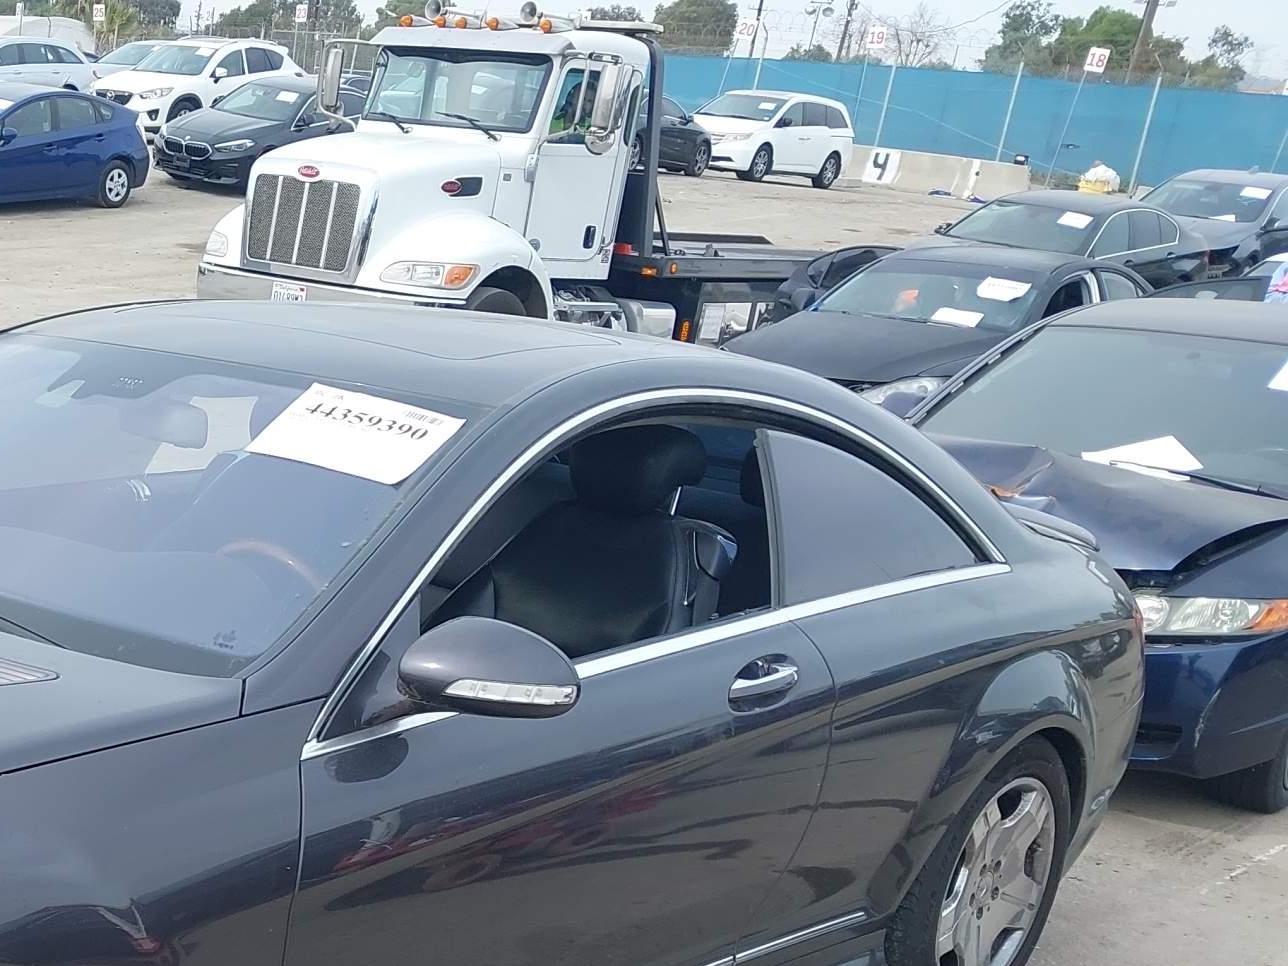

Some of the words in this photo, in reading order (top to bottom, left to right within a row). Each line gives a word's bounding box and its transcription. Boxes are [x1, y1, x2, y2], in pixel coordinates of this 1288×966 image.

[94, 7, 104, 18] 25
[296, 8, 307, 19] 23
[738, 22, 756, 37] 20
[868, 31, 885, 44] 19
[1087, 53, 1106, 67] 18
[872, 152, 890, 181] 4
[305, 402, 429, 440] 44359390
